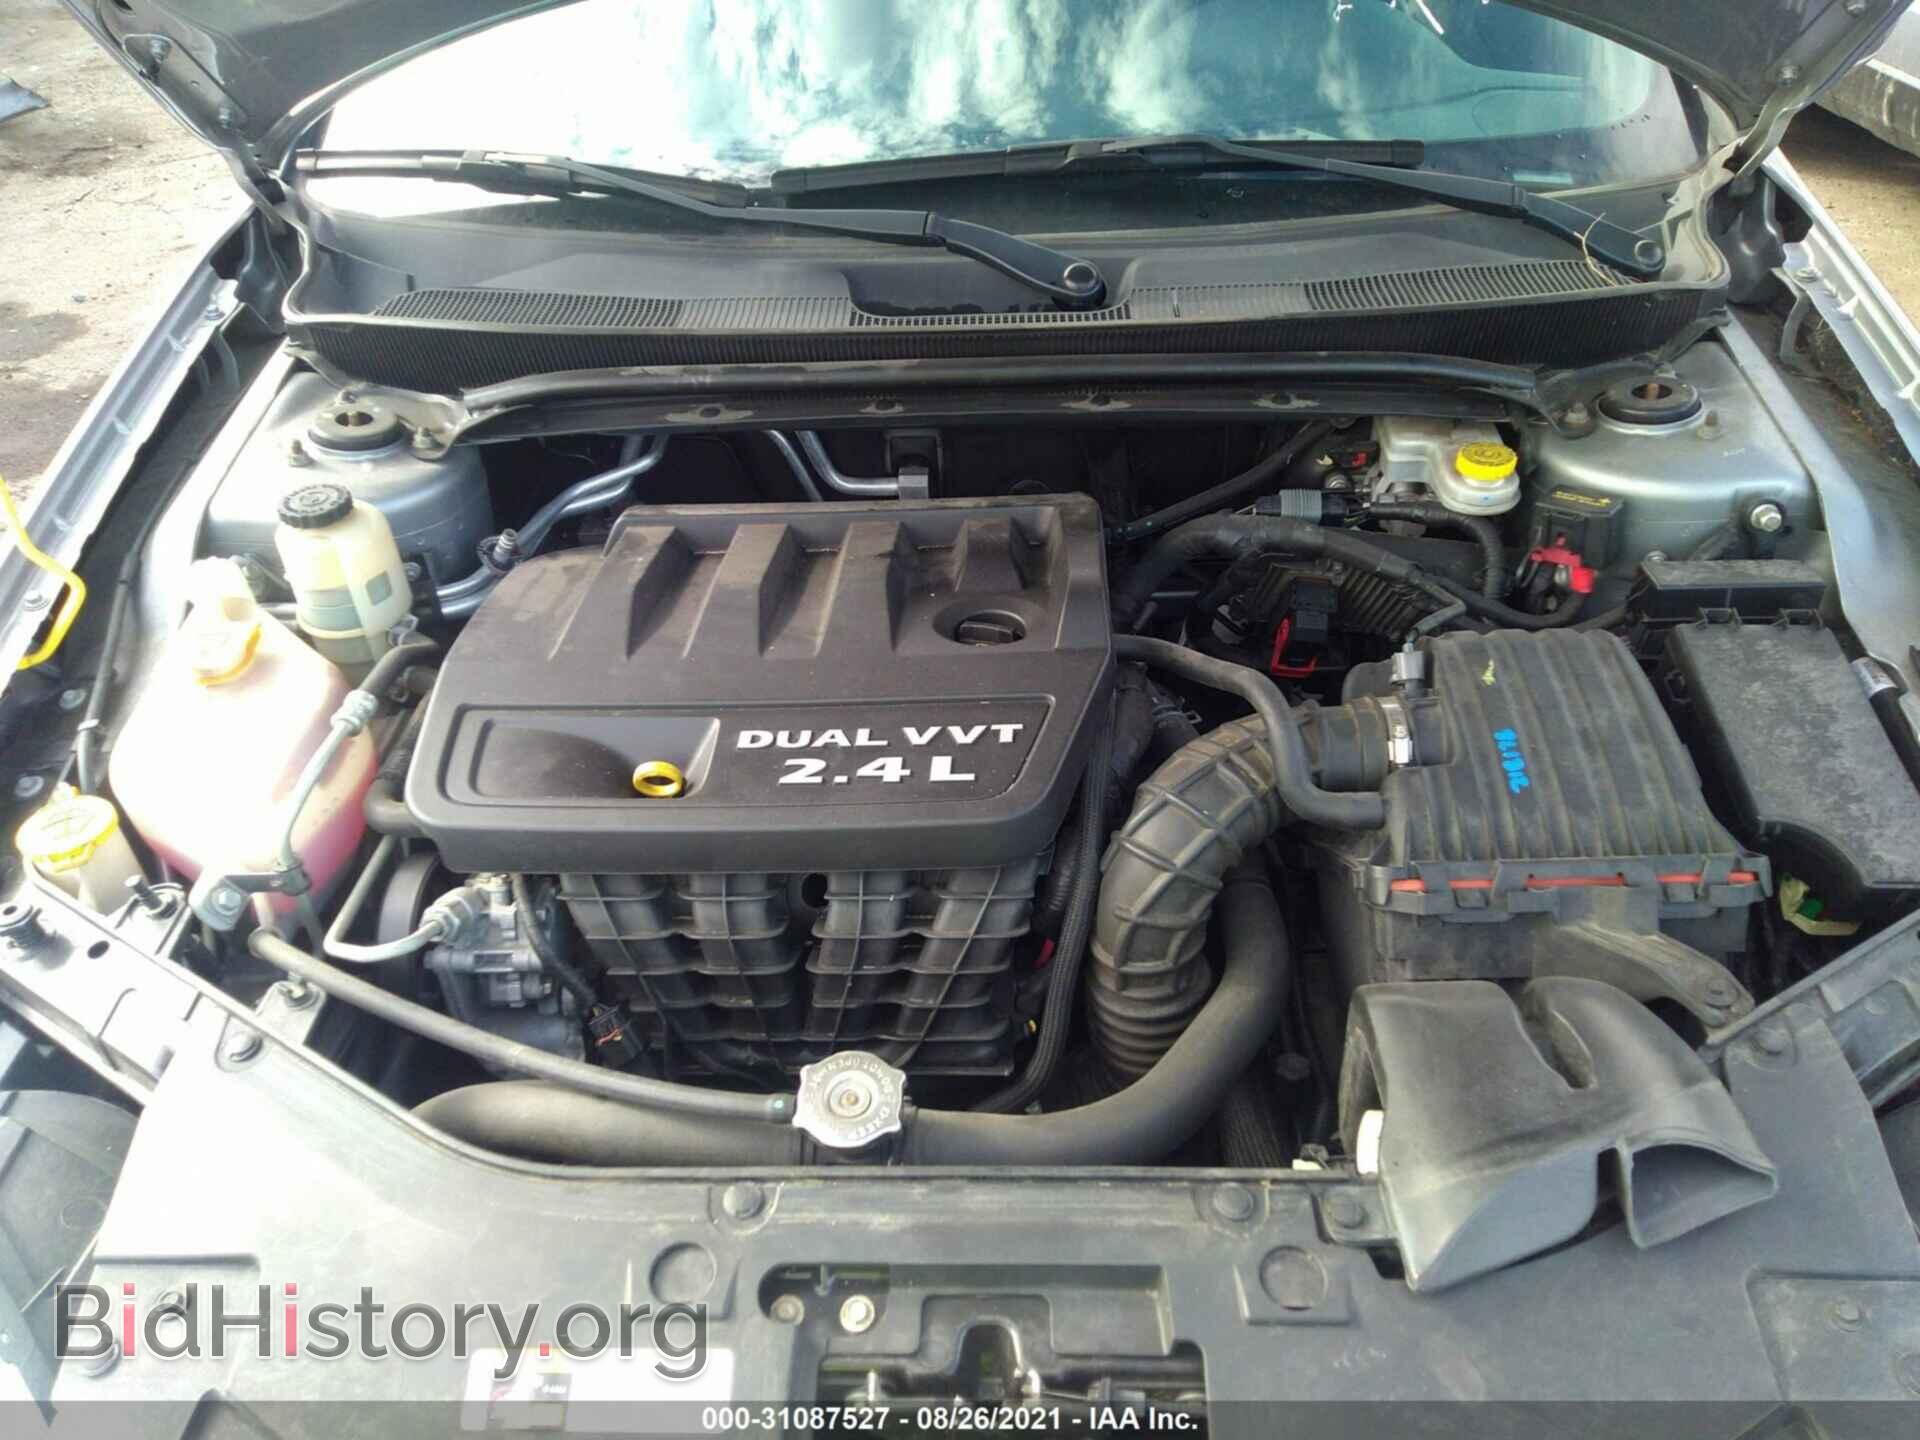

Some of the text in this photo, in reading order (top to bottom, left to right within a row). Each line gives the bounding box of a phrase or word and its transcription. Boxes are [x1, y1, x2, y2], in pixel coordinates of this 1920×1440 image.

[736, 723, 1025, 749] DUAL VVT
[777, 755, 976, 785] 2.4 L
